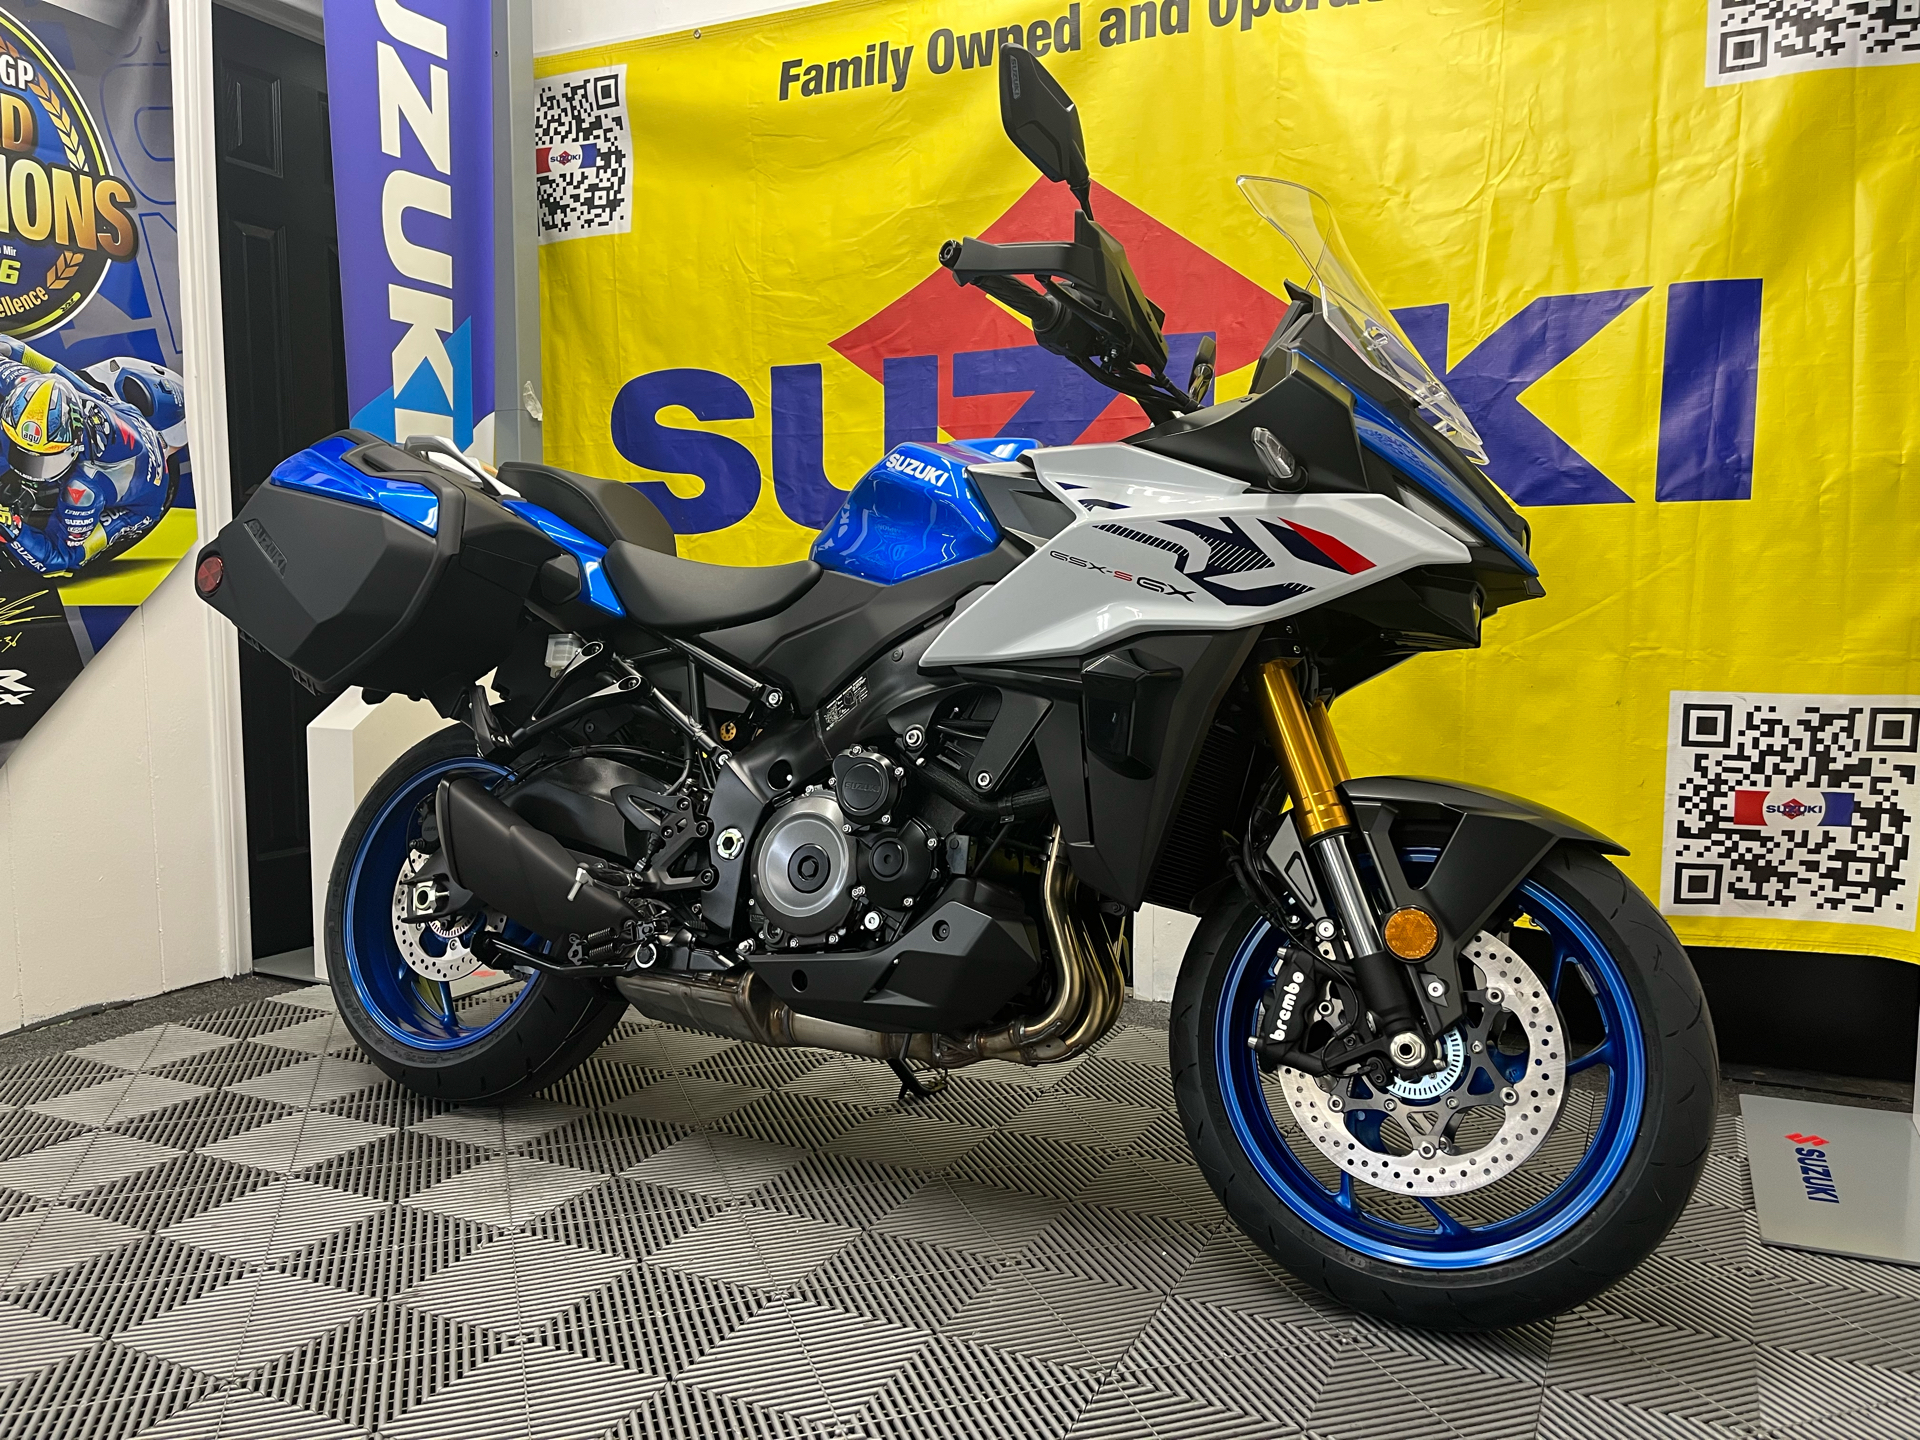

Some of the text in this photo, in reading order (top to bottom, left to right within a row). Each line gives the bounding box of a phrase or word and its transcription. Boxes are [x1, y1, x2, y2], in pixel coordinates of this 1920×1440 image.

[779, 41, 914, 101] Family
[1099, 0, 1189, 47] and
[0, 54, 34, 89] GP
[1010, 54, 1021, 99] SUZUKI
[550, 154, 581, 162] SUZUKI
[3, 245, 17, 257] Mir
[885, 453, 950, 487] SUZUKI
[10, 540, 47, 572] SUZUKI
[1050, 551, 1197, 603] GSX-S GX
[1766, 805, 1822, 813] SUZUKI
[1269, 971, 1304, 1041] brembo
[1795, 1146, 1840, 1204] SUZUKI
